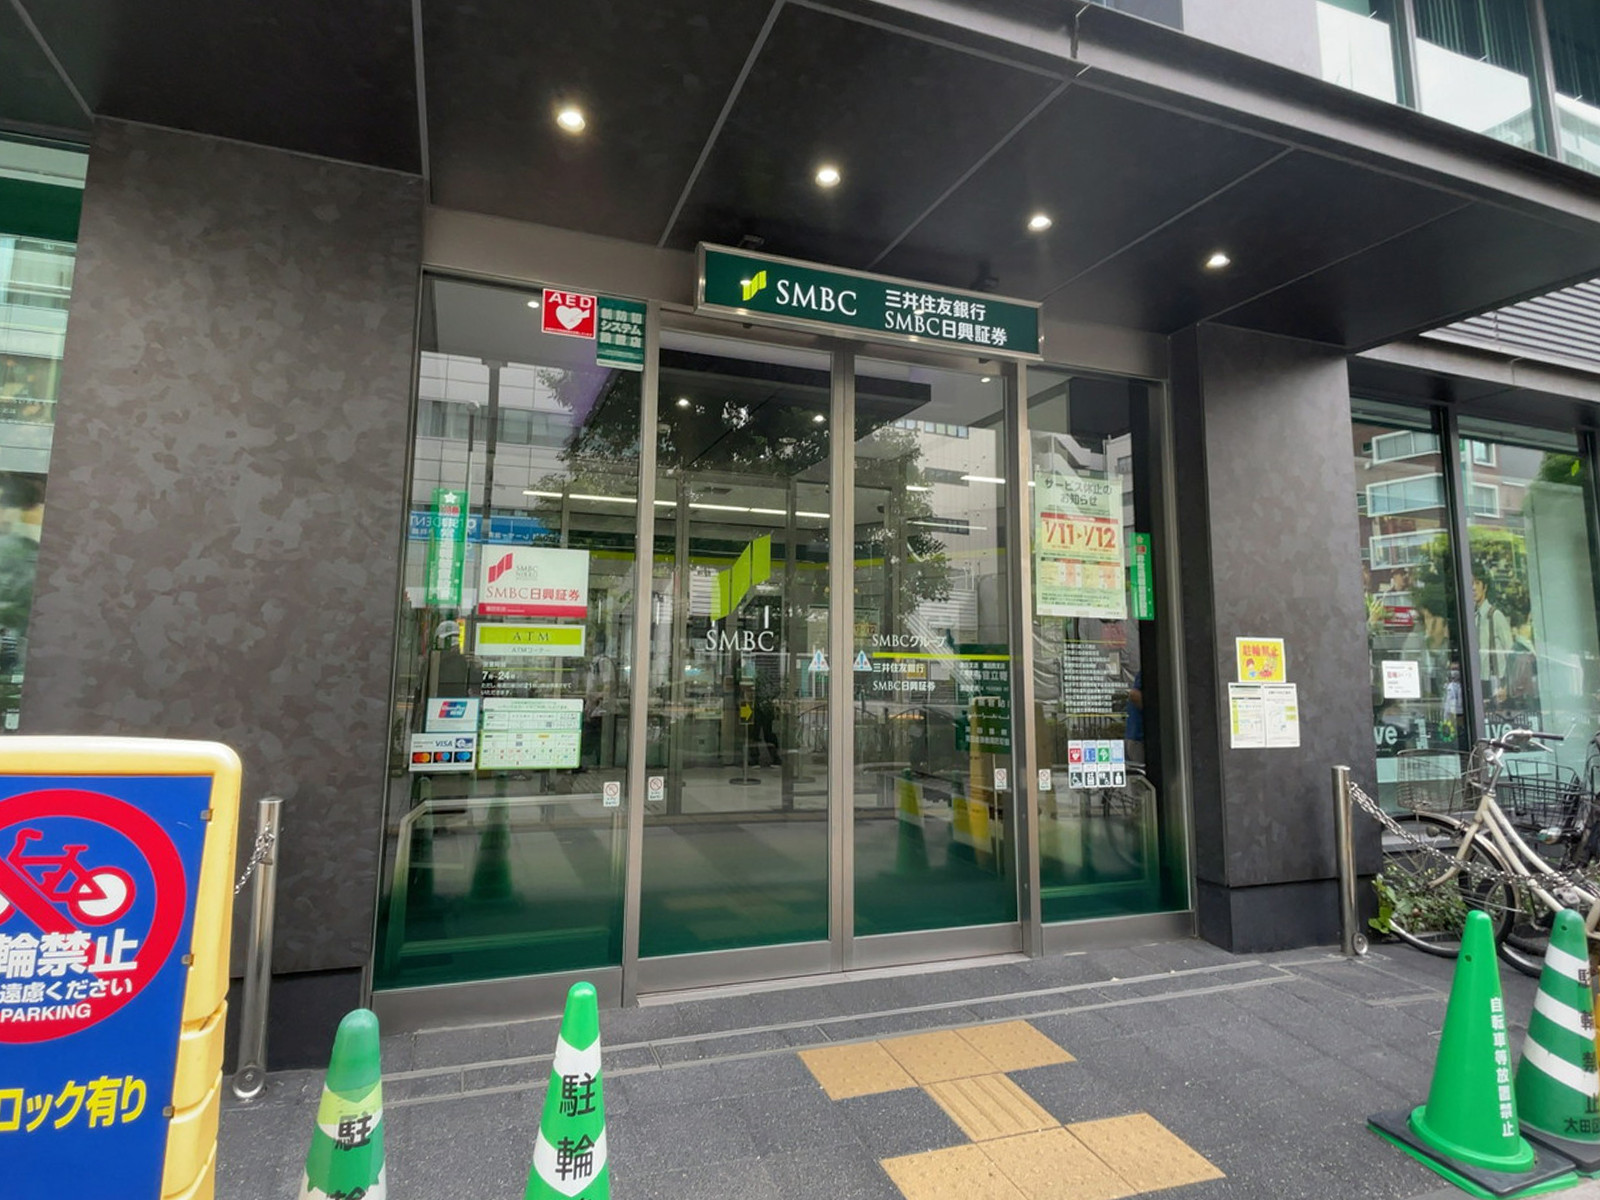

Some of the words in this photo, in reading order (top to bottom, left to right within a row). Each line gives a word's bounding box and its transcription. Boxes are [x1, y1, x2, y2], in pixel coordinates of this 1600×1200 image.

[548, 291, 592, 308] AED
[776, 279, 857, 316] SMBC
[885, 289, 986, 321] 三井住友銀行
[884, 310, 1008, 346] SMBC日興証券
[1045, 478, 1112, 496] サービス休止の
[1060, 492, 1097, 507] お知らせ
[486, 586, 580, 601] SMBC日興証券
[513, 631, 549, 641] ATM
[705, 629, 774, 652] SMBC
[873, 662, 925, 673] 三井住友銀行
[0, 928, 138, 979] 輪禁止
[0, 978, 133, 1004] 遠慮ください
[0, 1003, 92, 1023] PARKING
[0, 1075, 147, 1133] ロック有り
[554, 1072, 597, 1200] 駐輪
